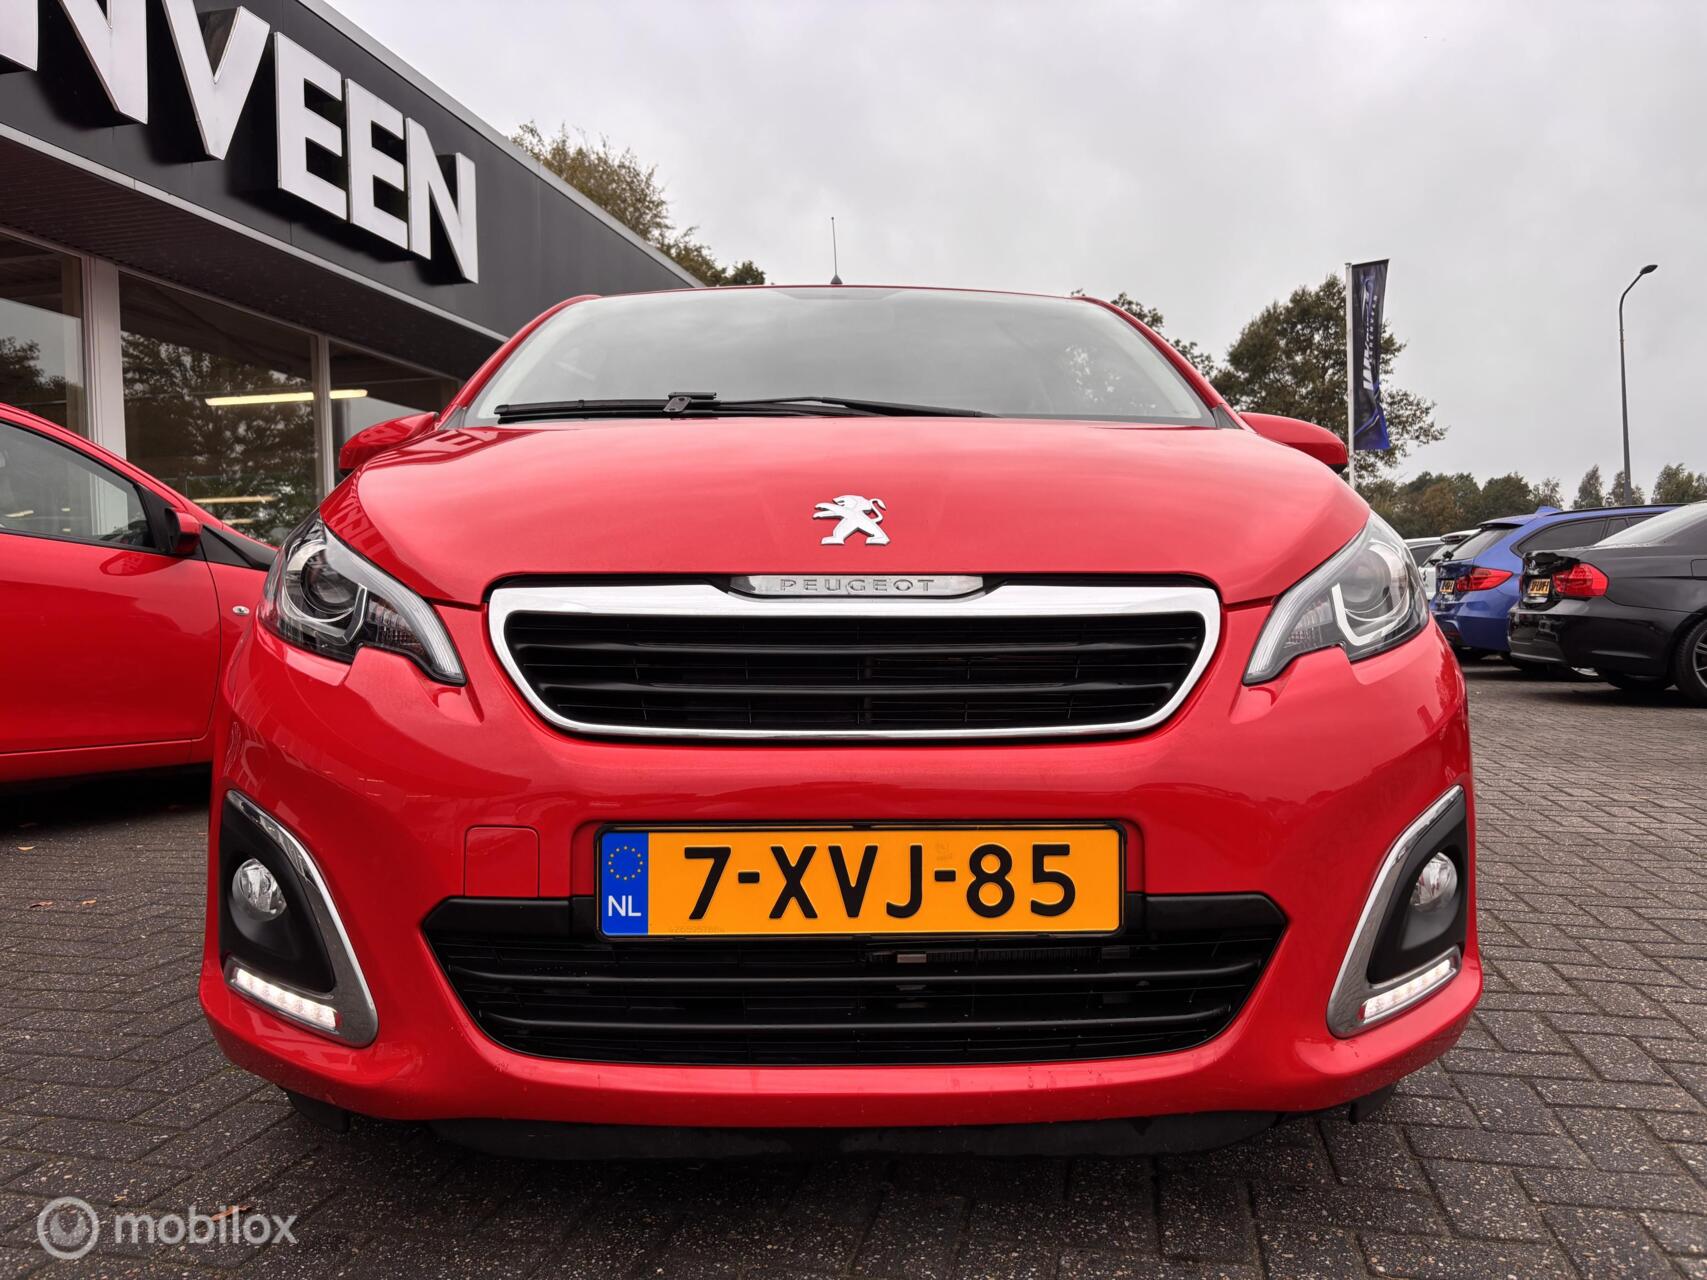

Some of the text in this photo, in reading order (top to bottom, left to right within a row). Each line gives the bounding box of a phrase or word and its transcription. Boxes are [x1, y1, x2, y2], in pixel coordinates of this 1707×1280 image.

[779, 578, 935, 592] PEUGEOT
[683, 842, 1077, 920] 7-XVJ-85
[607, 895, 642, 918] NL
